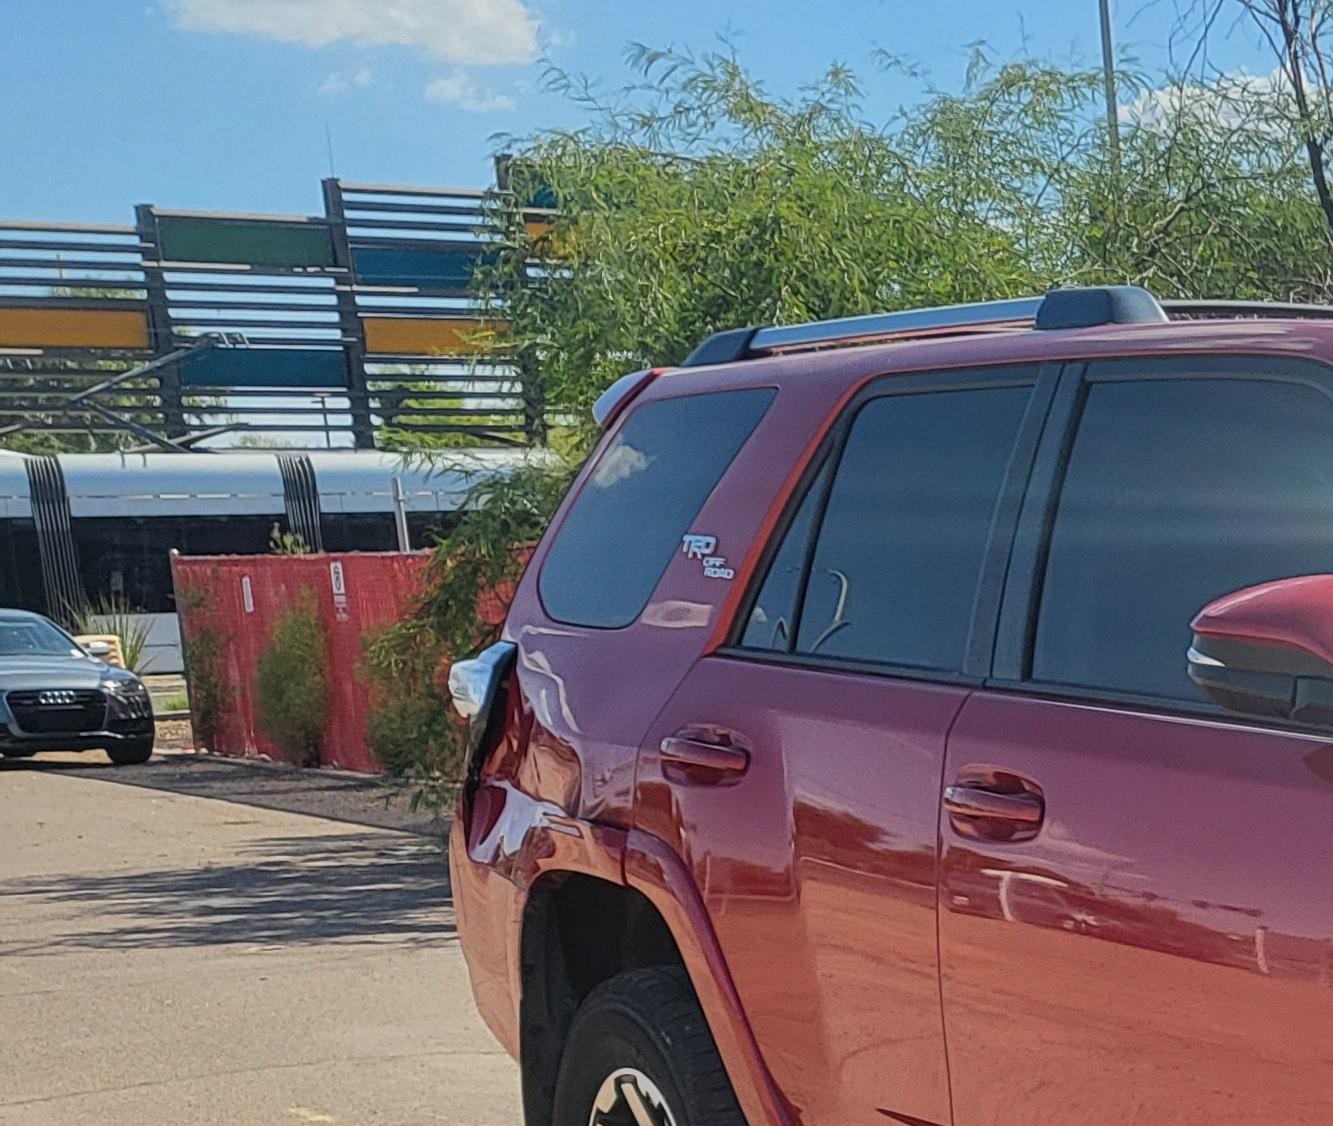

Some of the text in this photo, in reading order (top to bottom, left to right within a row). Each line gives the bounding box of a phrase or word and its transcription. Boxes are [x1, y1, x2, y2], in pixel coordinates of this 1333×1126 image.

[683, 534, 716, 559] TRD
[703, 557, 726, 567] OFF
[704, 567, 734, 579] ROAD
